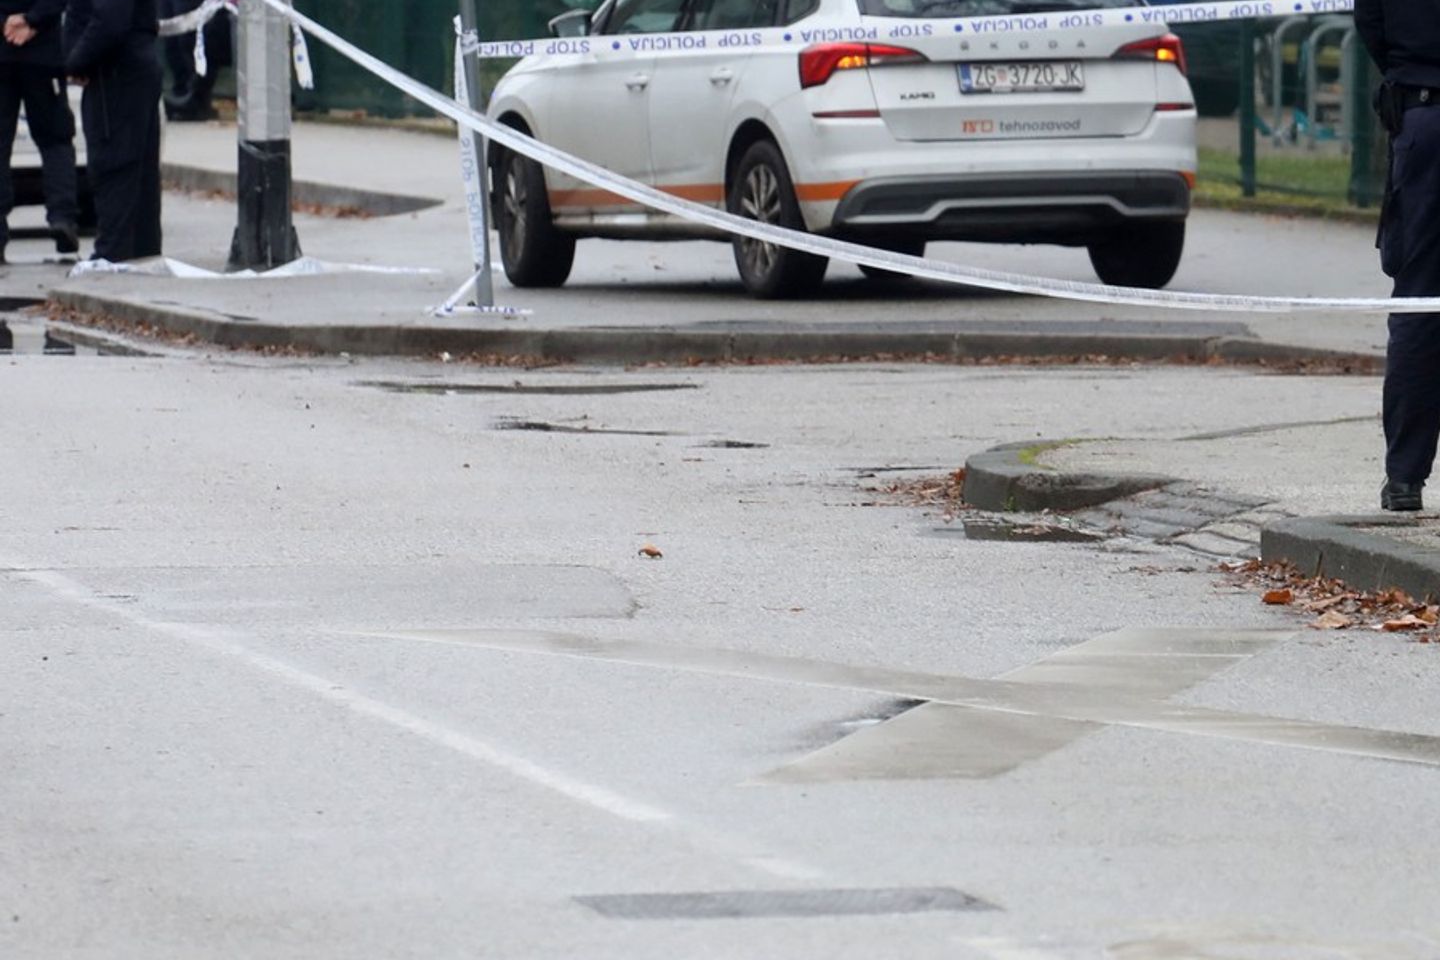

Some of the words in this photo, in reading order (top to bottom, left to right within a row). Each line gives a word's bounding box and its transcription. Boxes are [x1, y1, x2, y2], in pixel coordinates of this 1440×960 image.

[1141, 7, 1217, 22] POLICIJA
[1229, 3, 1273, 17] STOP
[971, 18, 1048, 32] POLICIJA
[1059, 13, 1103, 27] STOP
[800, 27, 877, 41] POLICIJA
[889, 24, 933, 37] STOP
[546, 40, 590, 54] STOP
[629, 37, 706, 51] POLICIJA
[717, 33, 762, 47] STOP
[974, 64, 998, 87] ZG
[1000, 118, 1081, 132] tehnozavod
